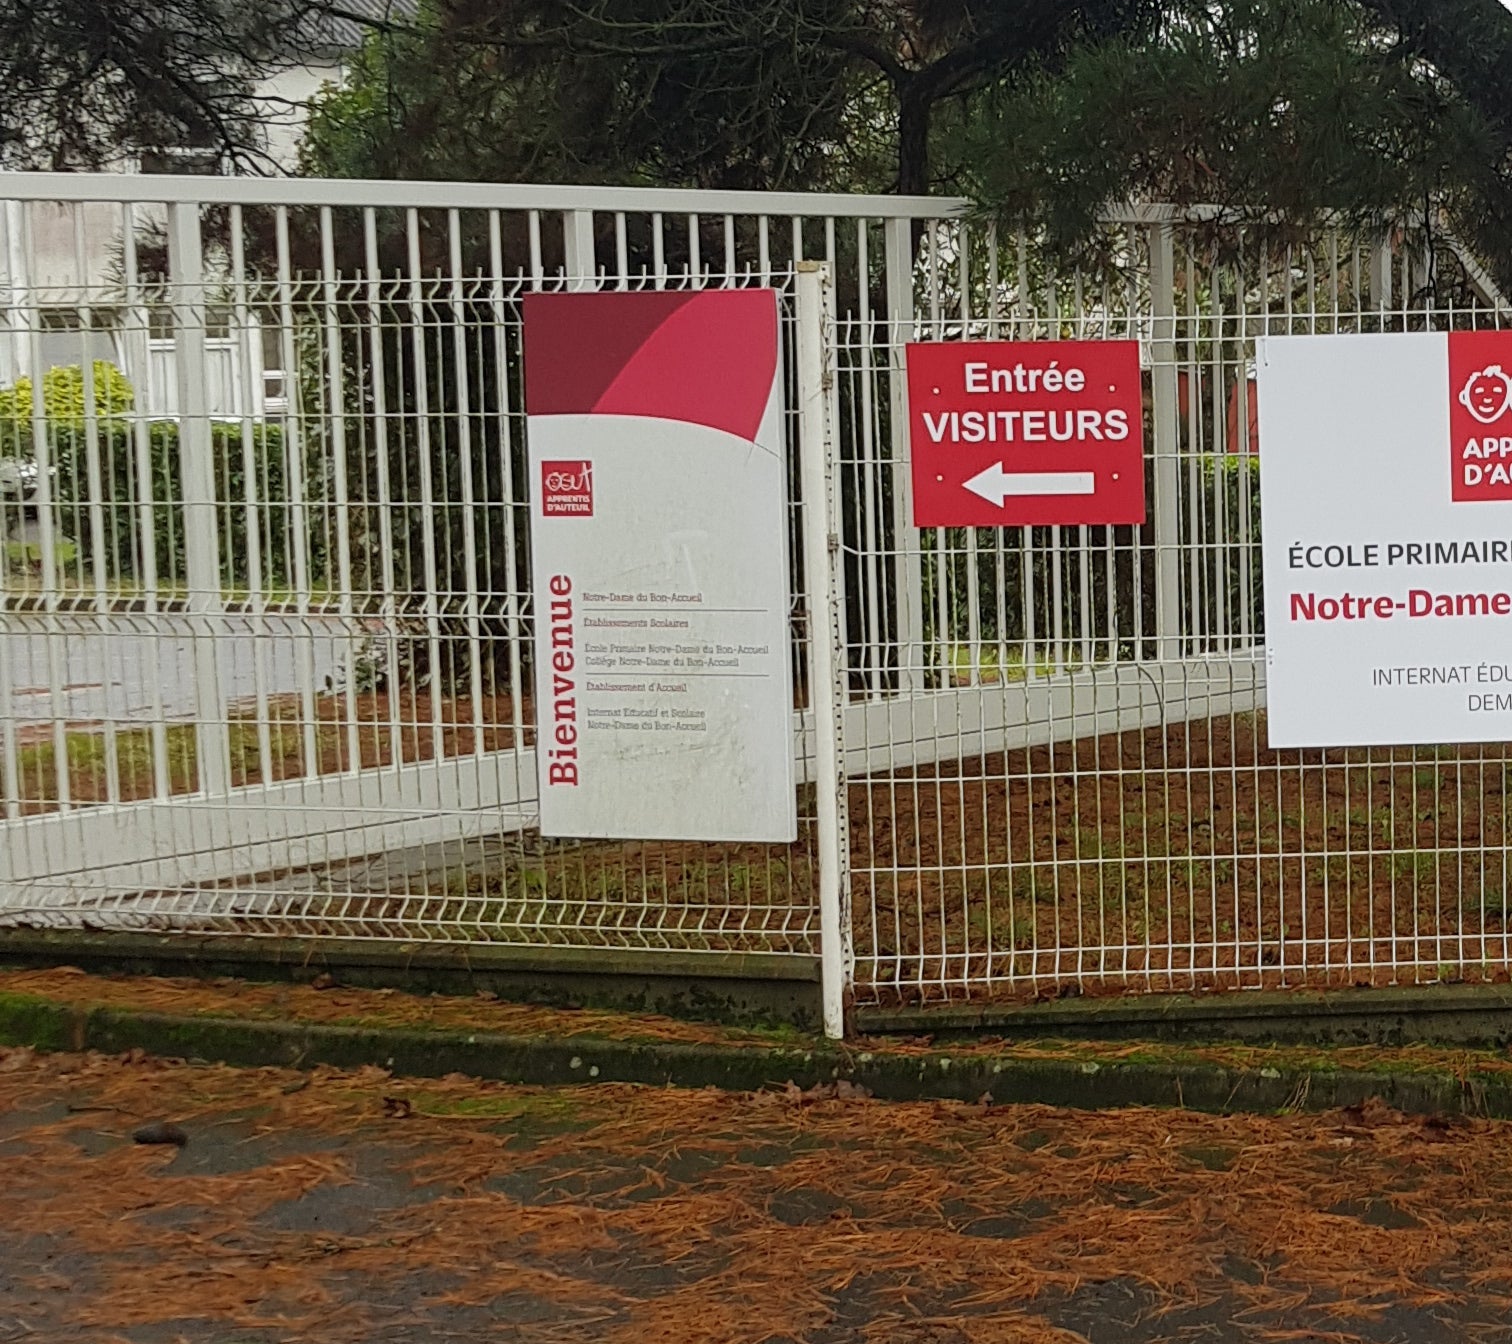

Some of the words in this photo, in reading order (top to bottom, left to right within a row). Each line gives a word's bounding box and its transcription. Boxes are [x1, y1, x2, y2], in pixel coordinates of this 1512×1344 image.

[965, 361, 1085, 393] Entrée
[922, 409, 1129, 443] VISITEURS
[547, 495, 590, 503] APPRENTIS
[548, 504, 590, 512] D'AUTEUIL
[1289, 537, 1379, 568] ÉCOLE
[583, 593, 633, 601] Notre-Dame
[637, 593, 648, 601] du
[1290, 588, 1511, 621] Notre-Dame
[650, 619, 688, 628] Scolaires
[610, 644, 645, 653] Primaire
[703, 645, 713, 653] du
[674, 658, 684, 666] du
[1373, 665, 1471, 686] INTERNAT
[549, 574, 579, 787] Bienvenue
[587, 708, 621, 716] Internat
[671, 709, 705, 717] Scolaire
[642, 721, 652, 730] du
